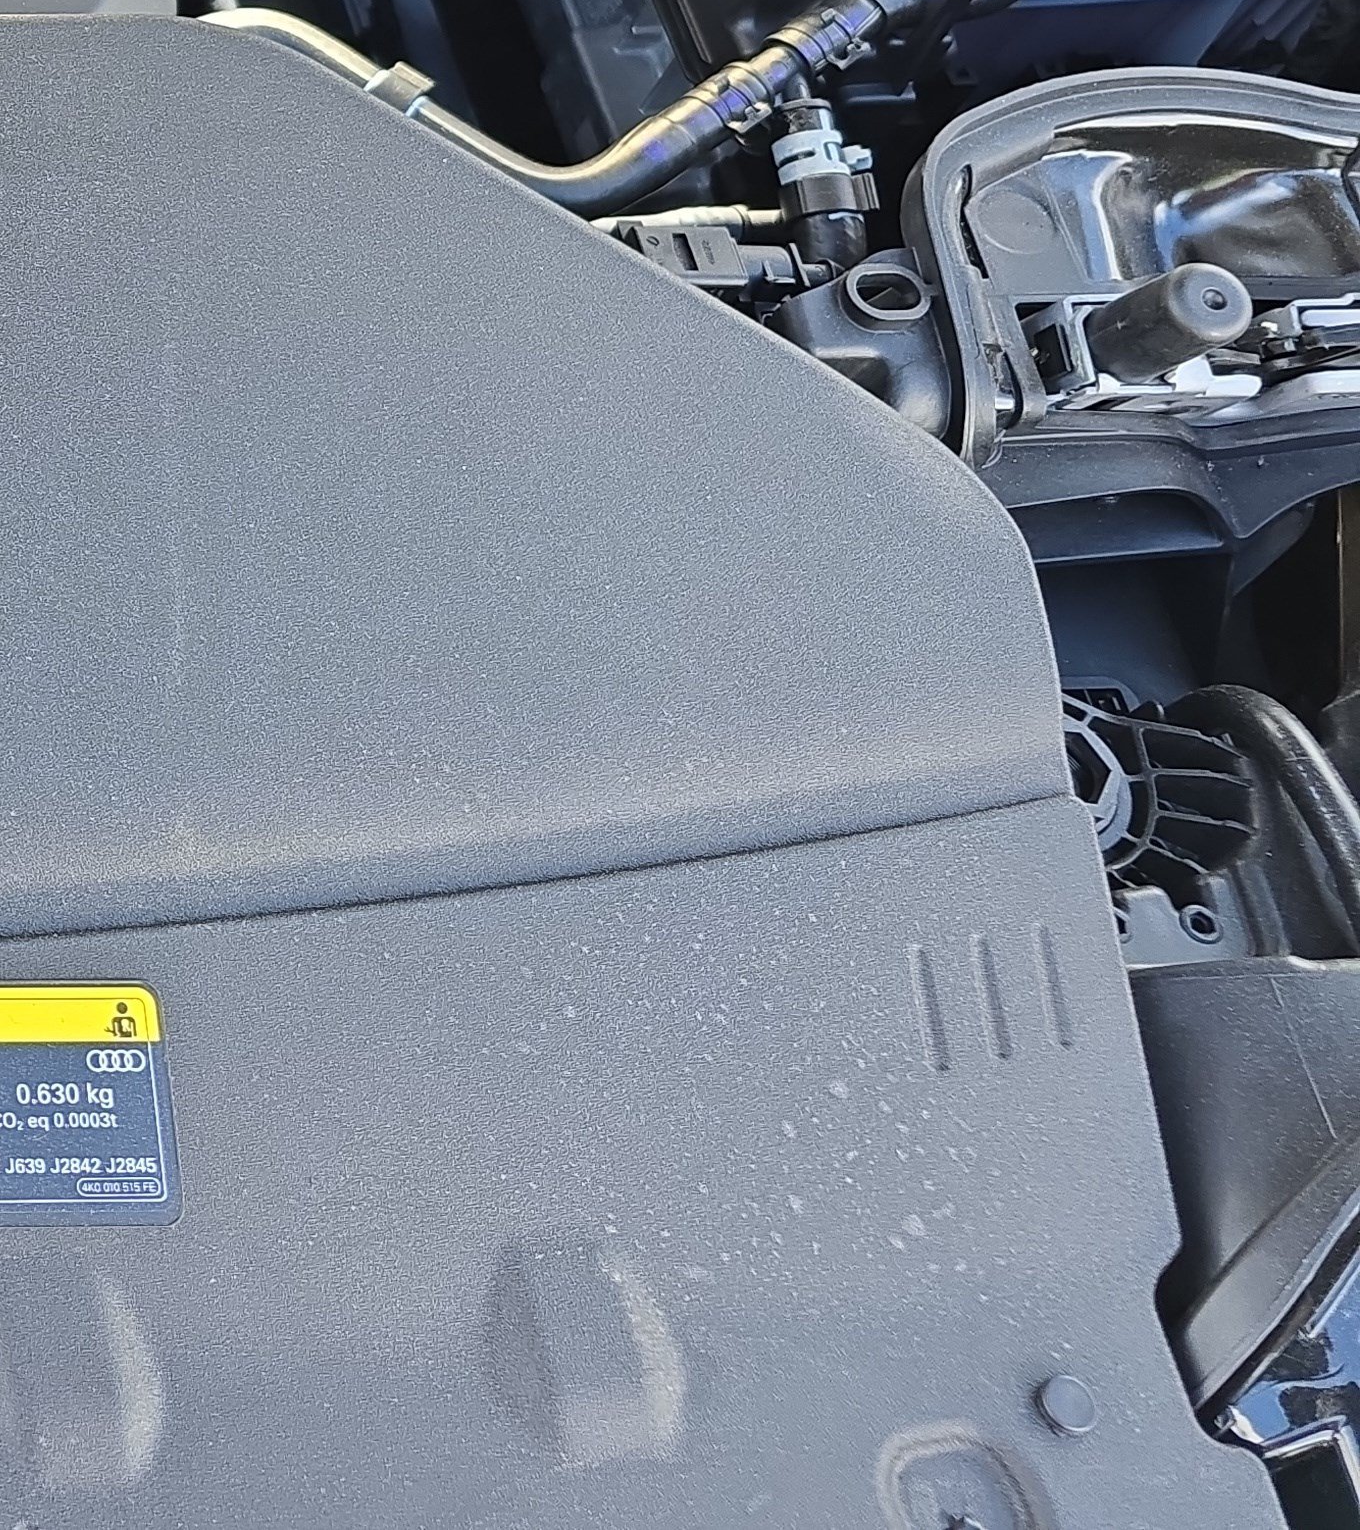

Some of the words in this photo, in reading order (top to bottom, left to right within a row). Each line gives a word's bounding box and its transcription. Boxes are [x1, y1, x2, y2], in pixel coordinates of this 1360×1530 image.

[15, 1083, 80, 1106] 0.630
[86, 1082, 115, 1109] kg
[27, 1115, 50, 1132] eq
[53, 1112, 119, 1129] 0.0003t
[4, 1158, 46, 1175] J639
[49, 1158, 101, 1175] J2842
[105, 1157, 157, 1174] J2845
[102, 1182, 120, 1193] 010
